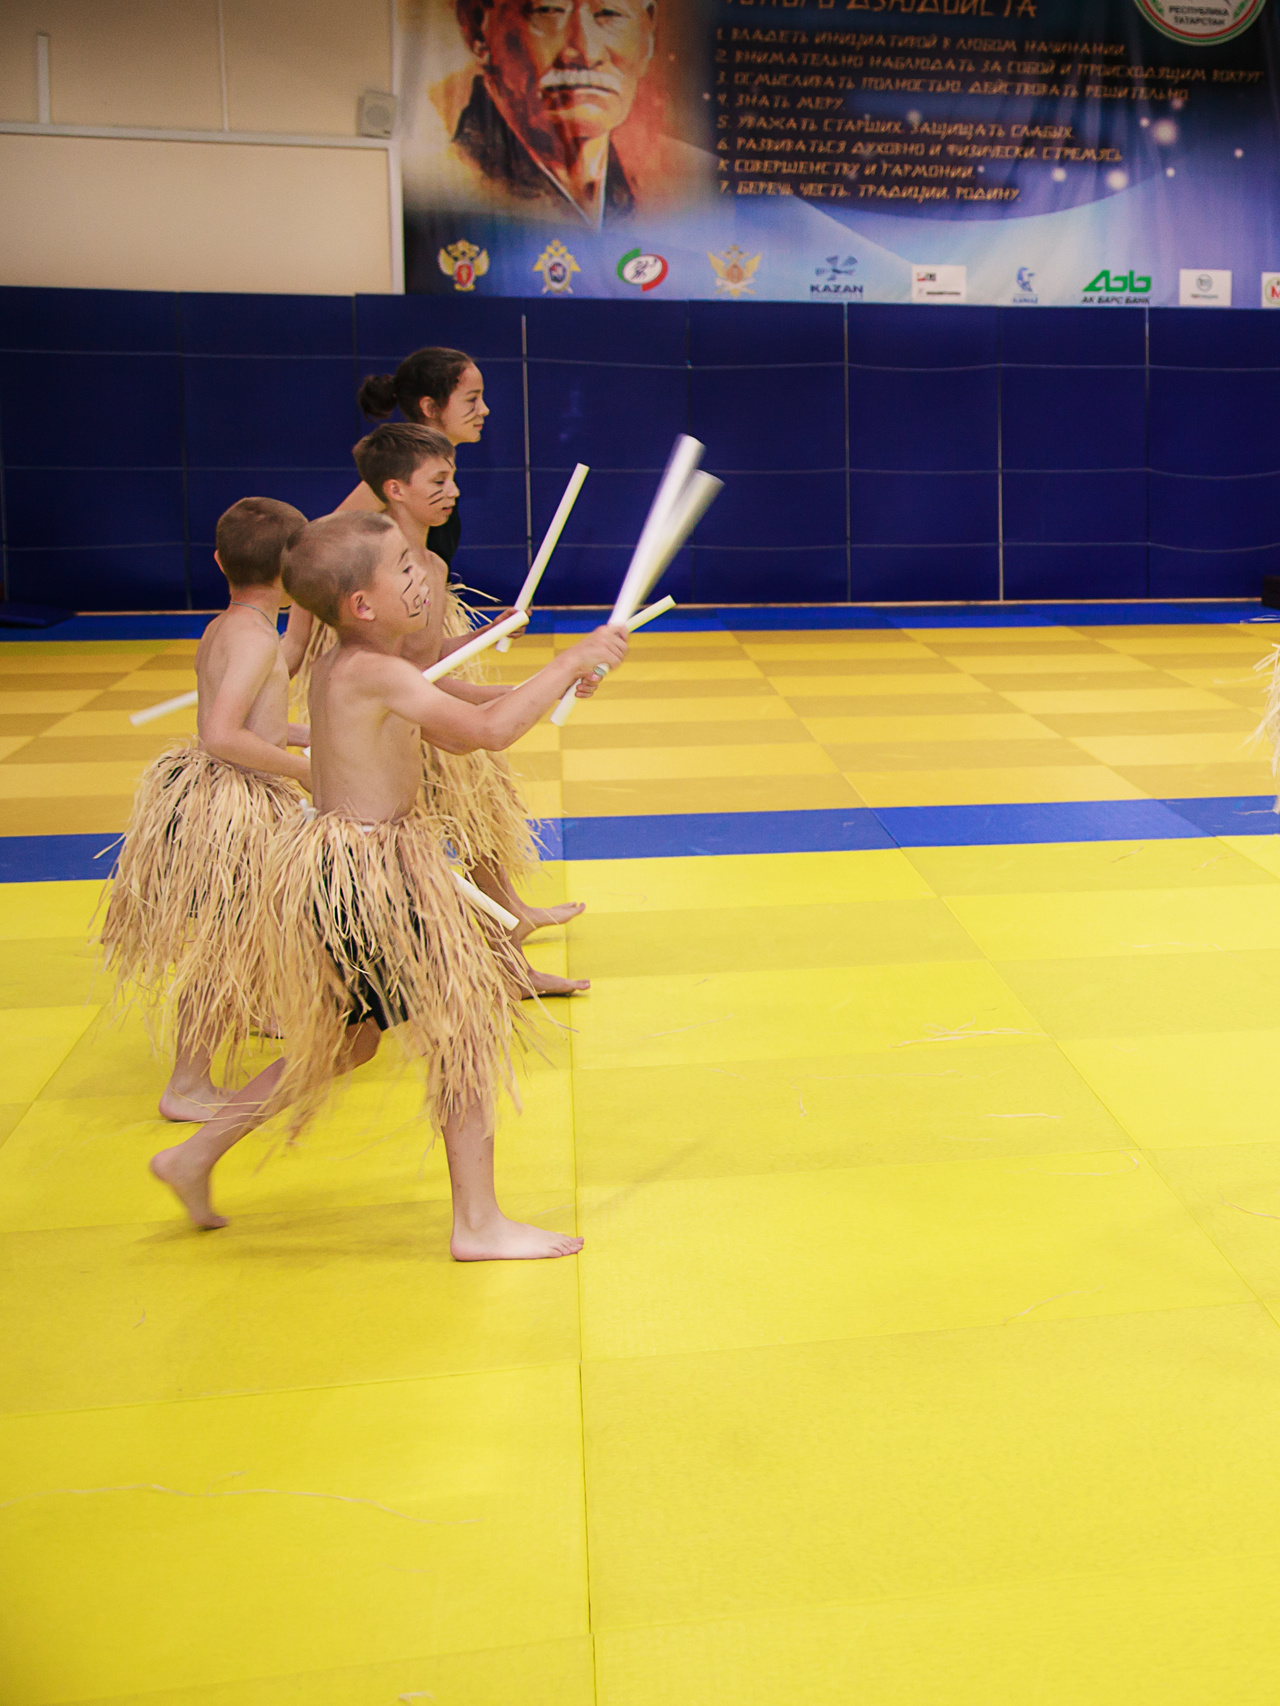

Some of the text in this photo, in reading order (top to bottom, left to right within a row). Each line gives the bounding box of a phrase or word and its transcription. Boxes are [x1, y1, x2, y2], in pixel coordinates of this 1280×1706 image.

[731, 27, 808, 44] ВЛАДЕТЬ
[814, 31, 938, 51] ИНИЦИАТИВОЙ
[942, 36, 952, 50] В
[955, 37, 1018, 52] ЛЮБОМ
[734, 49, 864, 69] ВНИМАТЕЛЬНО
[869, 55, 976, 73] НАБЛЮДАТЬ
[980, 59, 1002, 74] ЗА
[1006, 58, 1056, 76] СОБОЙ
[1060, 64, 1072, 76] И
[1077, 63, 1206, 84] ПРОИСХОДЯЩИМ
[734, 71, 856, 90] ОСМЫСЛИВАТЬ
[967, 78, 1079, 99] ДЕЙСТВОВАТЬ
[735, 93, 791, 109] ЗНАТЬ
[737, 115, 818, 132] УВАЖАТЬ
[910, 121, 1006, 141] ЗАЩИЩАТЬ
[736, 136, 847, 154] РАЗВИВАТЬСЯ
[851, 140, 925, 157] ДУХОВНО
[928, 143, 942, 157] И
[1042, 146, 1123, 162] СТРЕМЯСЬ
[717, 158, 729, 173] К
[734, 159, 861, 177] СОВЕРШЕНСТВУ
[864, 162, 878, 177] И
[718, 179, 732, 195] 7.
[736, 180, 794, 196] БЕРЕЧЬ
[810, 284, 863, 293] KAZAN
